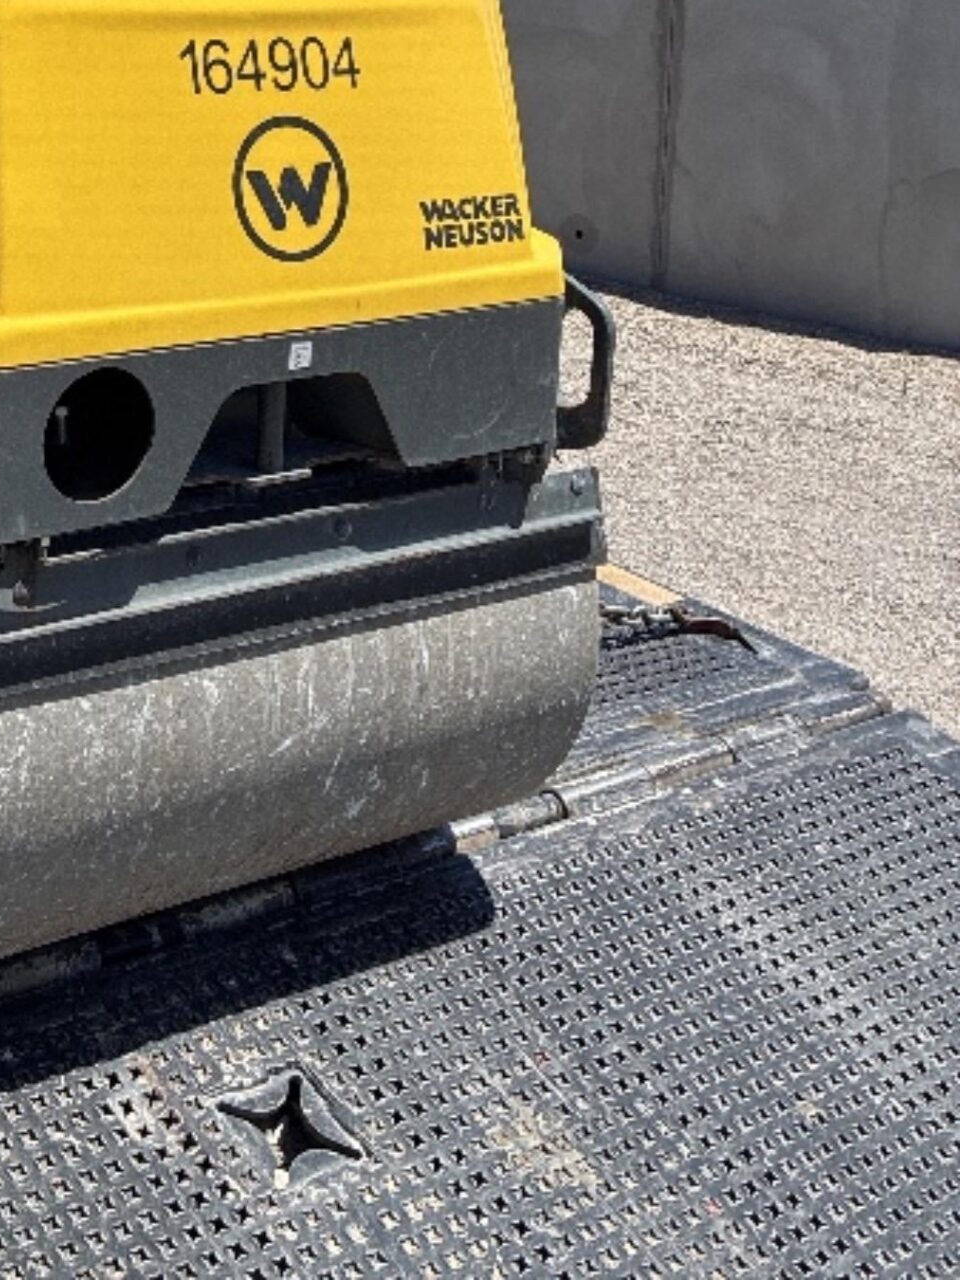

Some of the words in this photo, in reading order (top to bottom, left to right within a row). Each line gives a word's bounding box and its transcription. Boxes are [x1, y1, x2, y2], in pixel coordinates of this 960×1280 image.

[179, 36, 360, 95] 164904
[419, 193, 521, 223] WACKER
[424, 219, 525, 250] NEUSON
